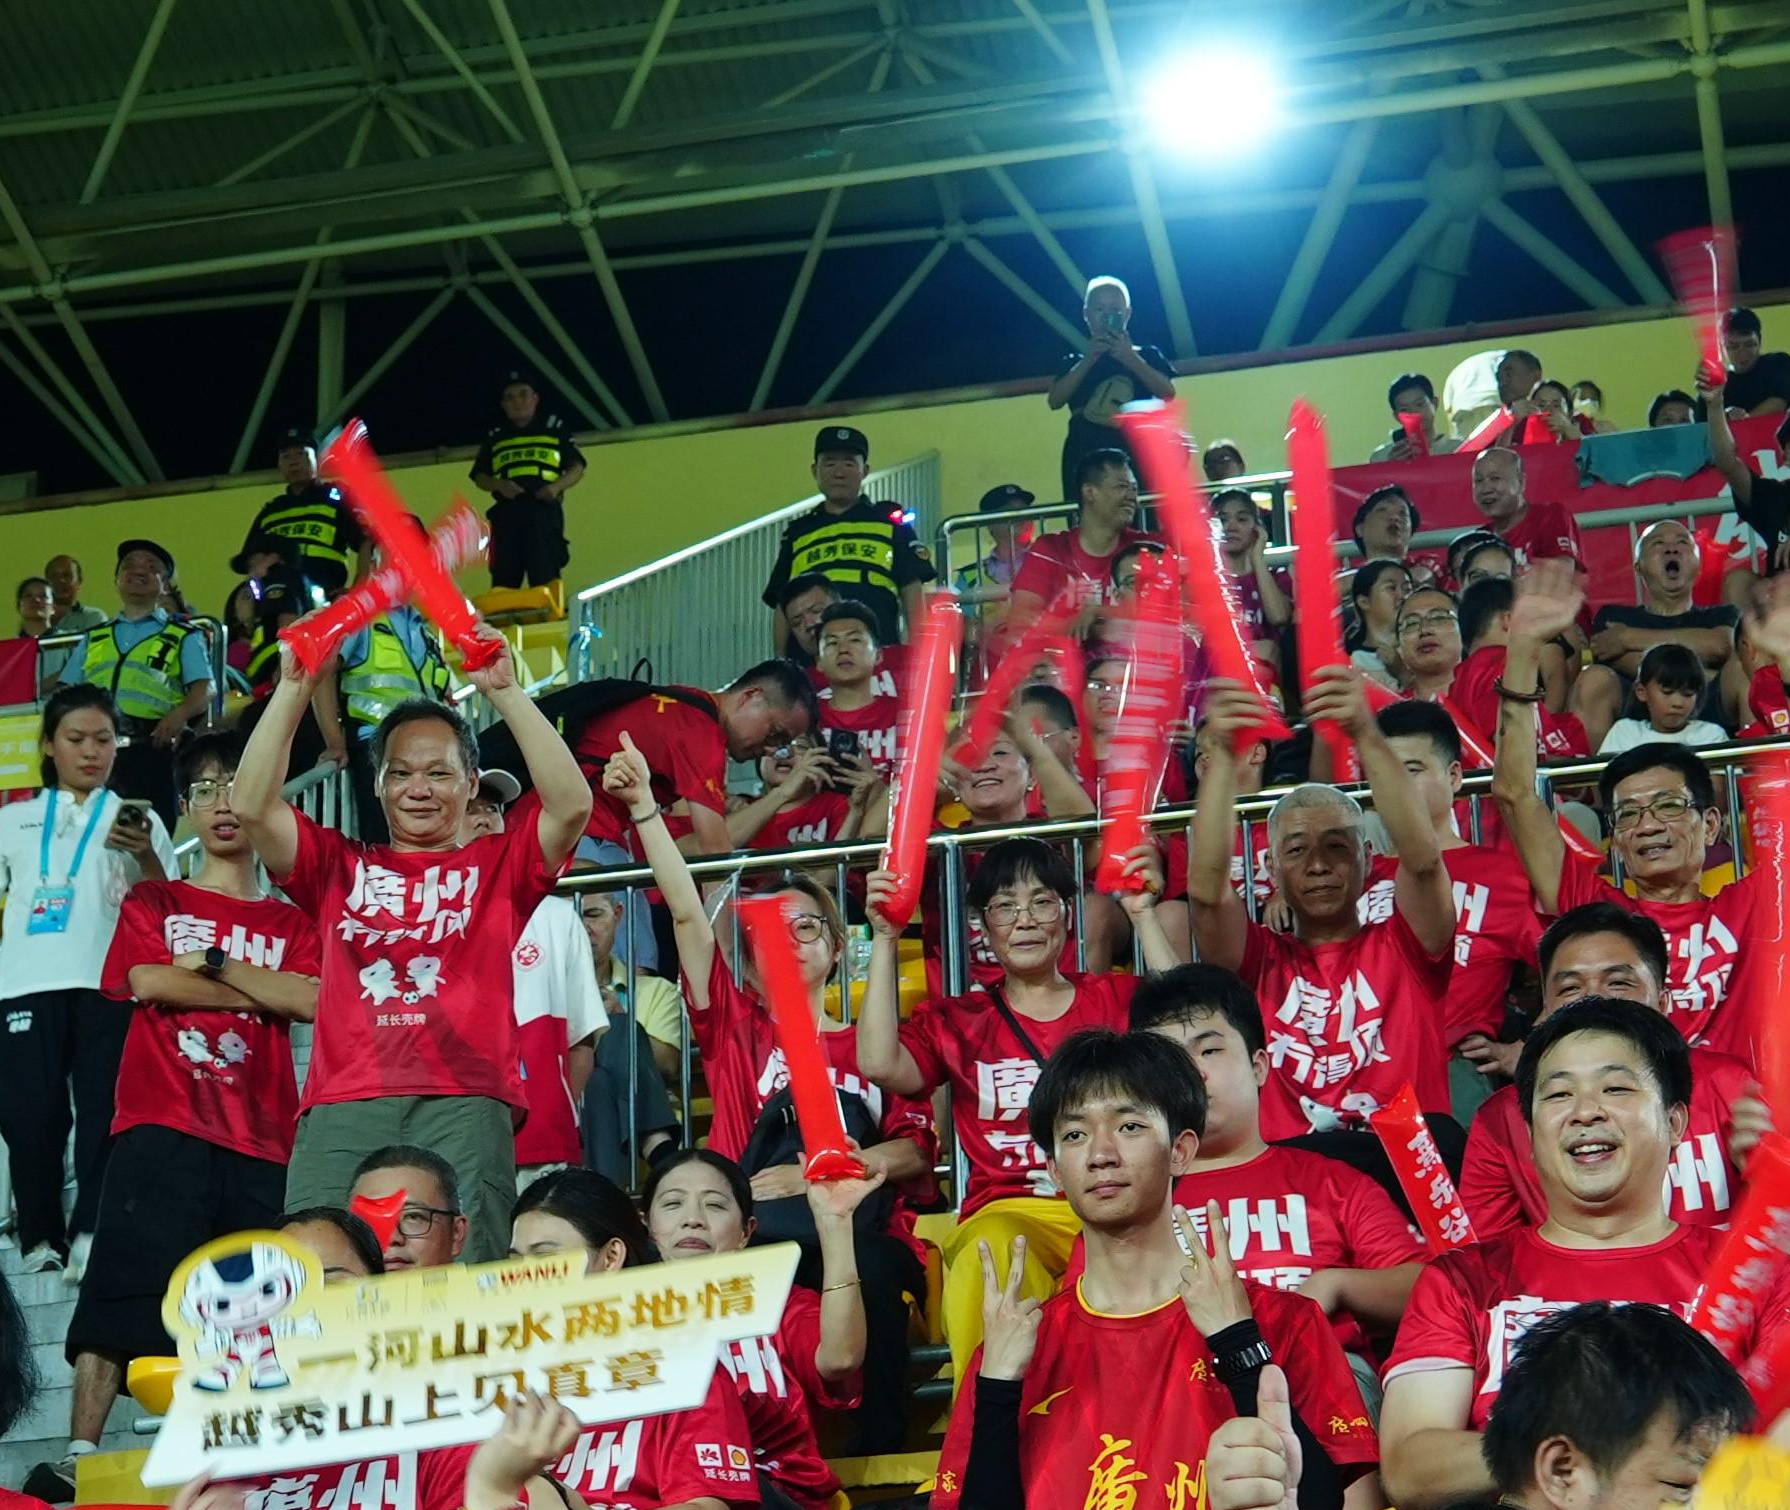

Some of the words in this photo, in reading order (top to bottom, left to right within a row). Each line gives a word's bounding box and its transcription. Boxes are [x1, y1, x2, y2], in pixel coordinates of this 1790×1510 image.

[346, 857, 480, 931] 廣州
[376, 1012, 428, 1028] 延长壳牌
[1275, 968, 1380, 1046] 廣州
[1663, 1132, 1730, 1213] 州
[297, 1273, 756, 1376] 一河山水两地情
[201, 1348, 666, 1454] 越秀山上见真章
[704, 1467, 751, 1484] 延长壳牌
